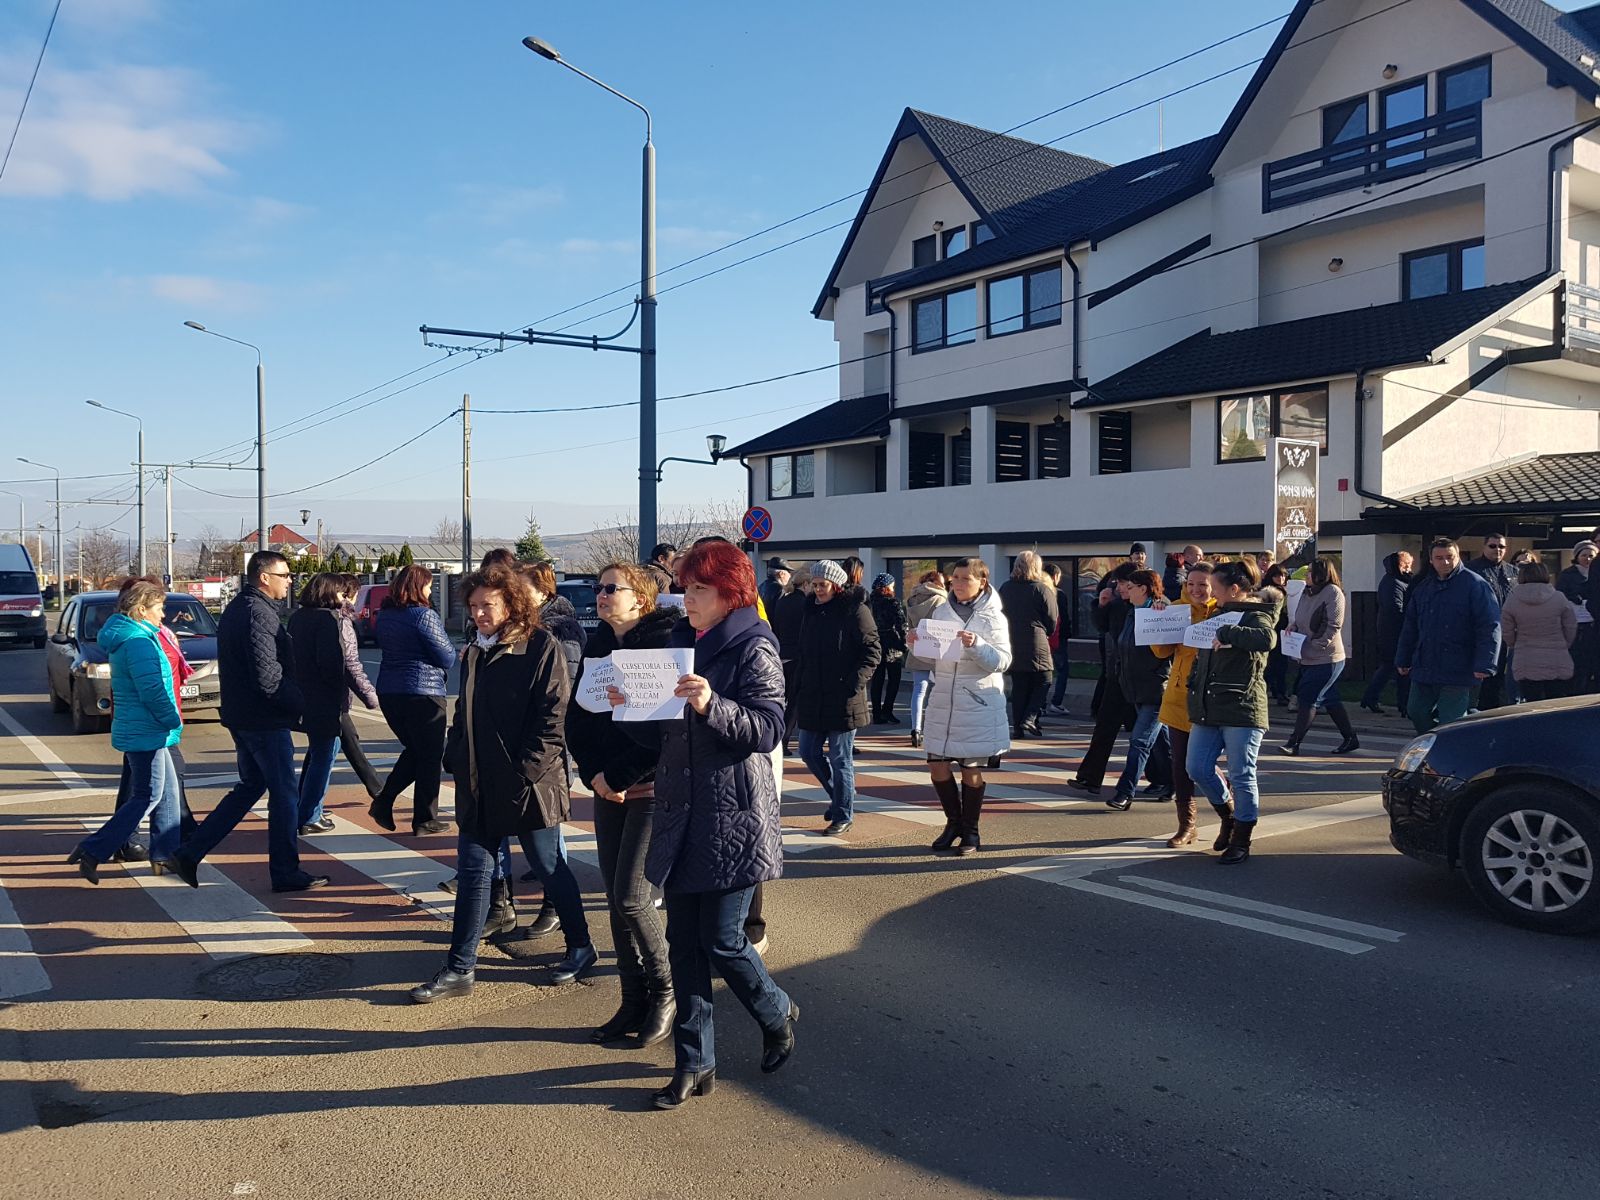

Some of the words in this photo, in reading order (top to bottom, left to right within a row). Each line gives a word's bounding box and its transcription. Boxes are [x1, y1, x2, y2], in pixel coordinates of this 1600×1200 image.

[663, 662, 681, 670] ESTE
[623, 682, 632, 690] NU
[655, 681, 664, 690] SĂ
